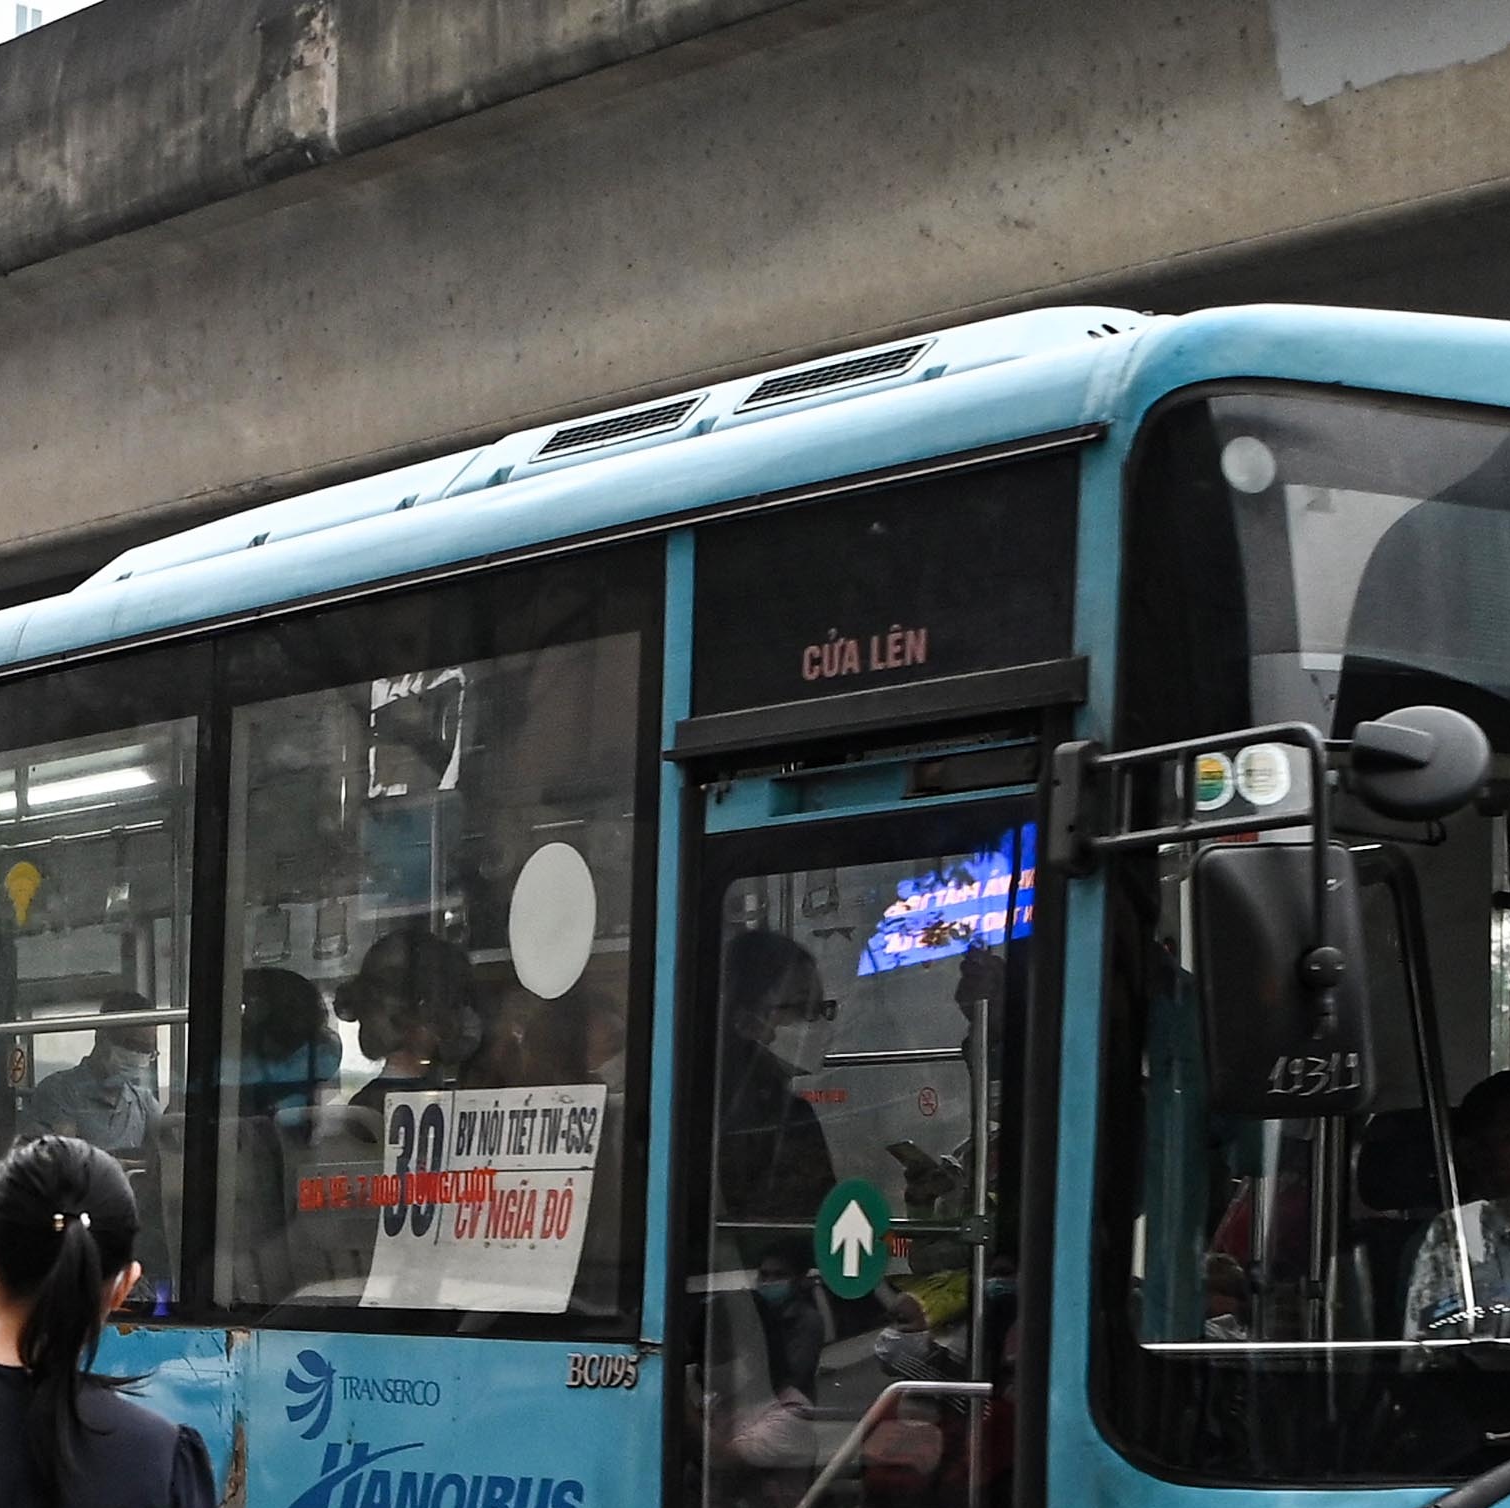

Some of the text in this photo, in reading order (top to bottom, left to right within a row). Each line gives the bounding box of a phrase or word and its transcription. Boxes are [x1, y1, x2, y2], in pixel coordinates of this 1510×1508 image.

[802, 623, 927, 680] CỬA LÊN
[455, 1111, 477, 1156] BV
[565, 1352, 641, 1389] BC095
[338, 1375, 441, 1408] TRANSERCO
